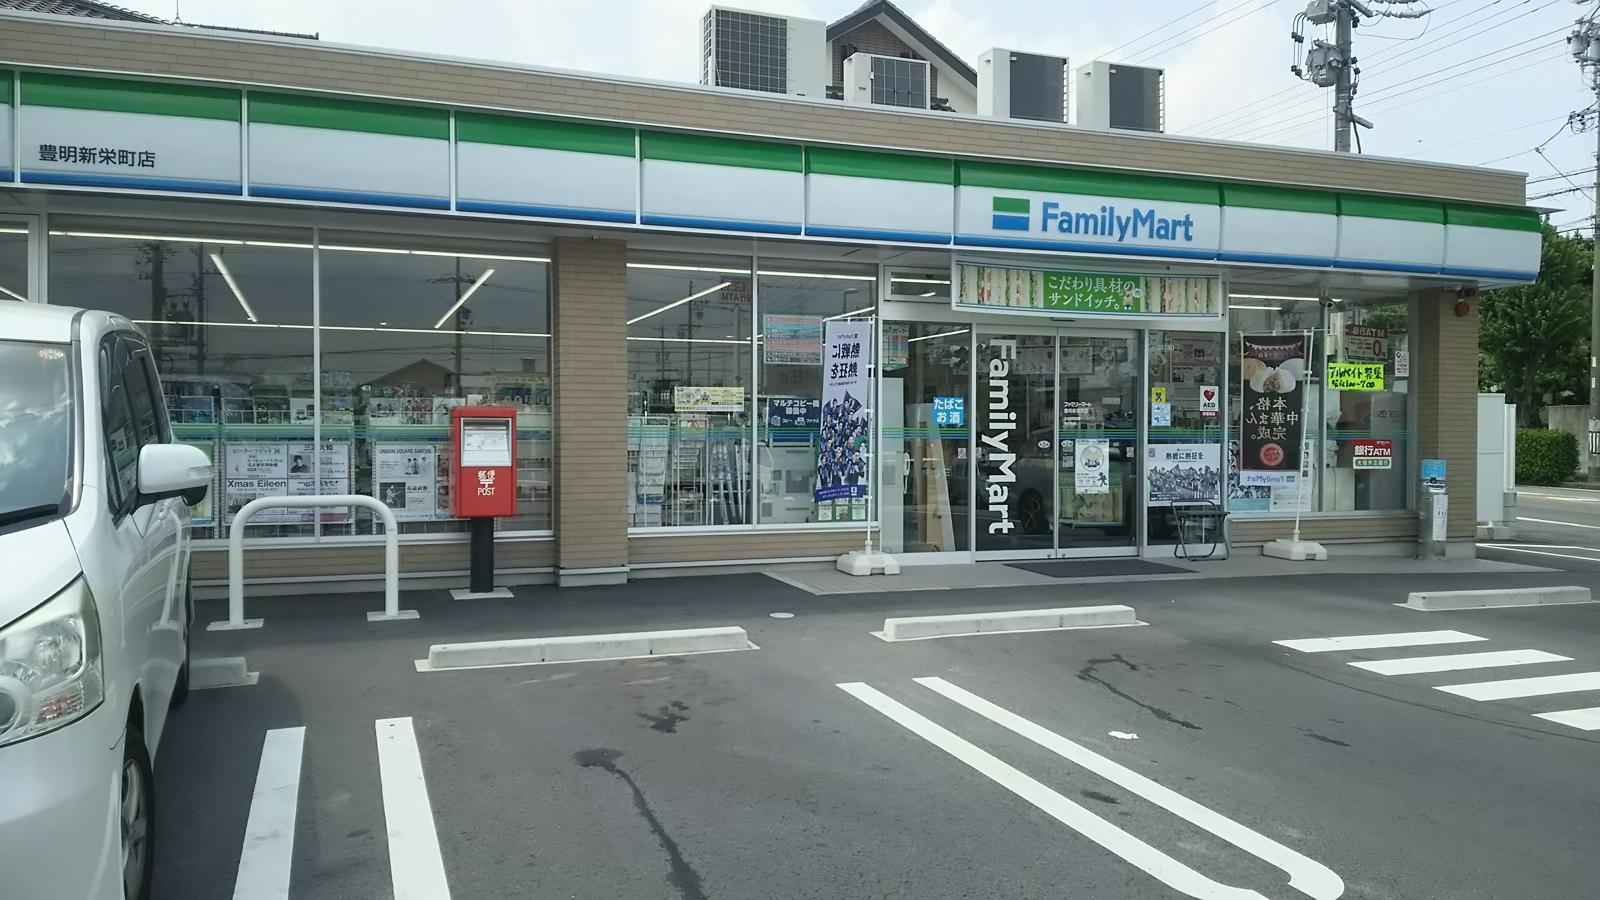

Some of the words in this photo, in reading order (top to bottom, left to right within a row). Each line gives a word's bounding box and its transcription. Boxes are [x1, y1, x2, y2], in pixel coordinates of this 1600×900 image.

[38, 143, 156, 168] 豊明新栄町店
[1041, 201, 1194, 242] FamilyMart
[1048, 274, 1135, 294] こだわり具材の
[1048, 291, 1120, 310] サンドイッチ。
[934, 398, 964, 410] たばこ
[936, 411, 960, 424] お酒
[981, 339, 1017, 535] FamilyMart
[1166, 452, 1204, 460] 熱戦に熱狂を
[1354, 445, 1391, 456] 銀行ATM
[477, 470, 496, 480] 郵便
[227, 480, 254, 488] Xmas
[257, 480, 287, 488] Eileen
[477, 487, 496, 496] POST
